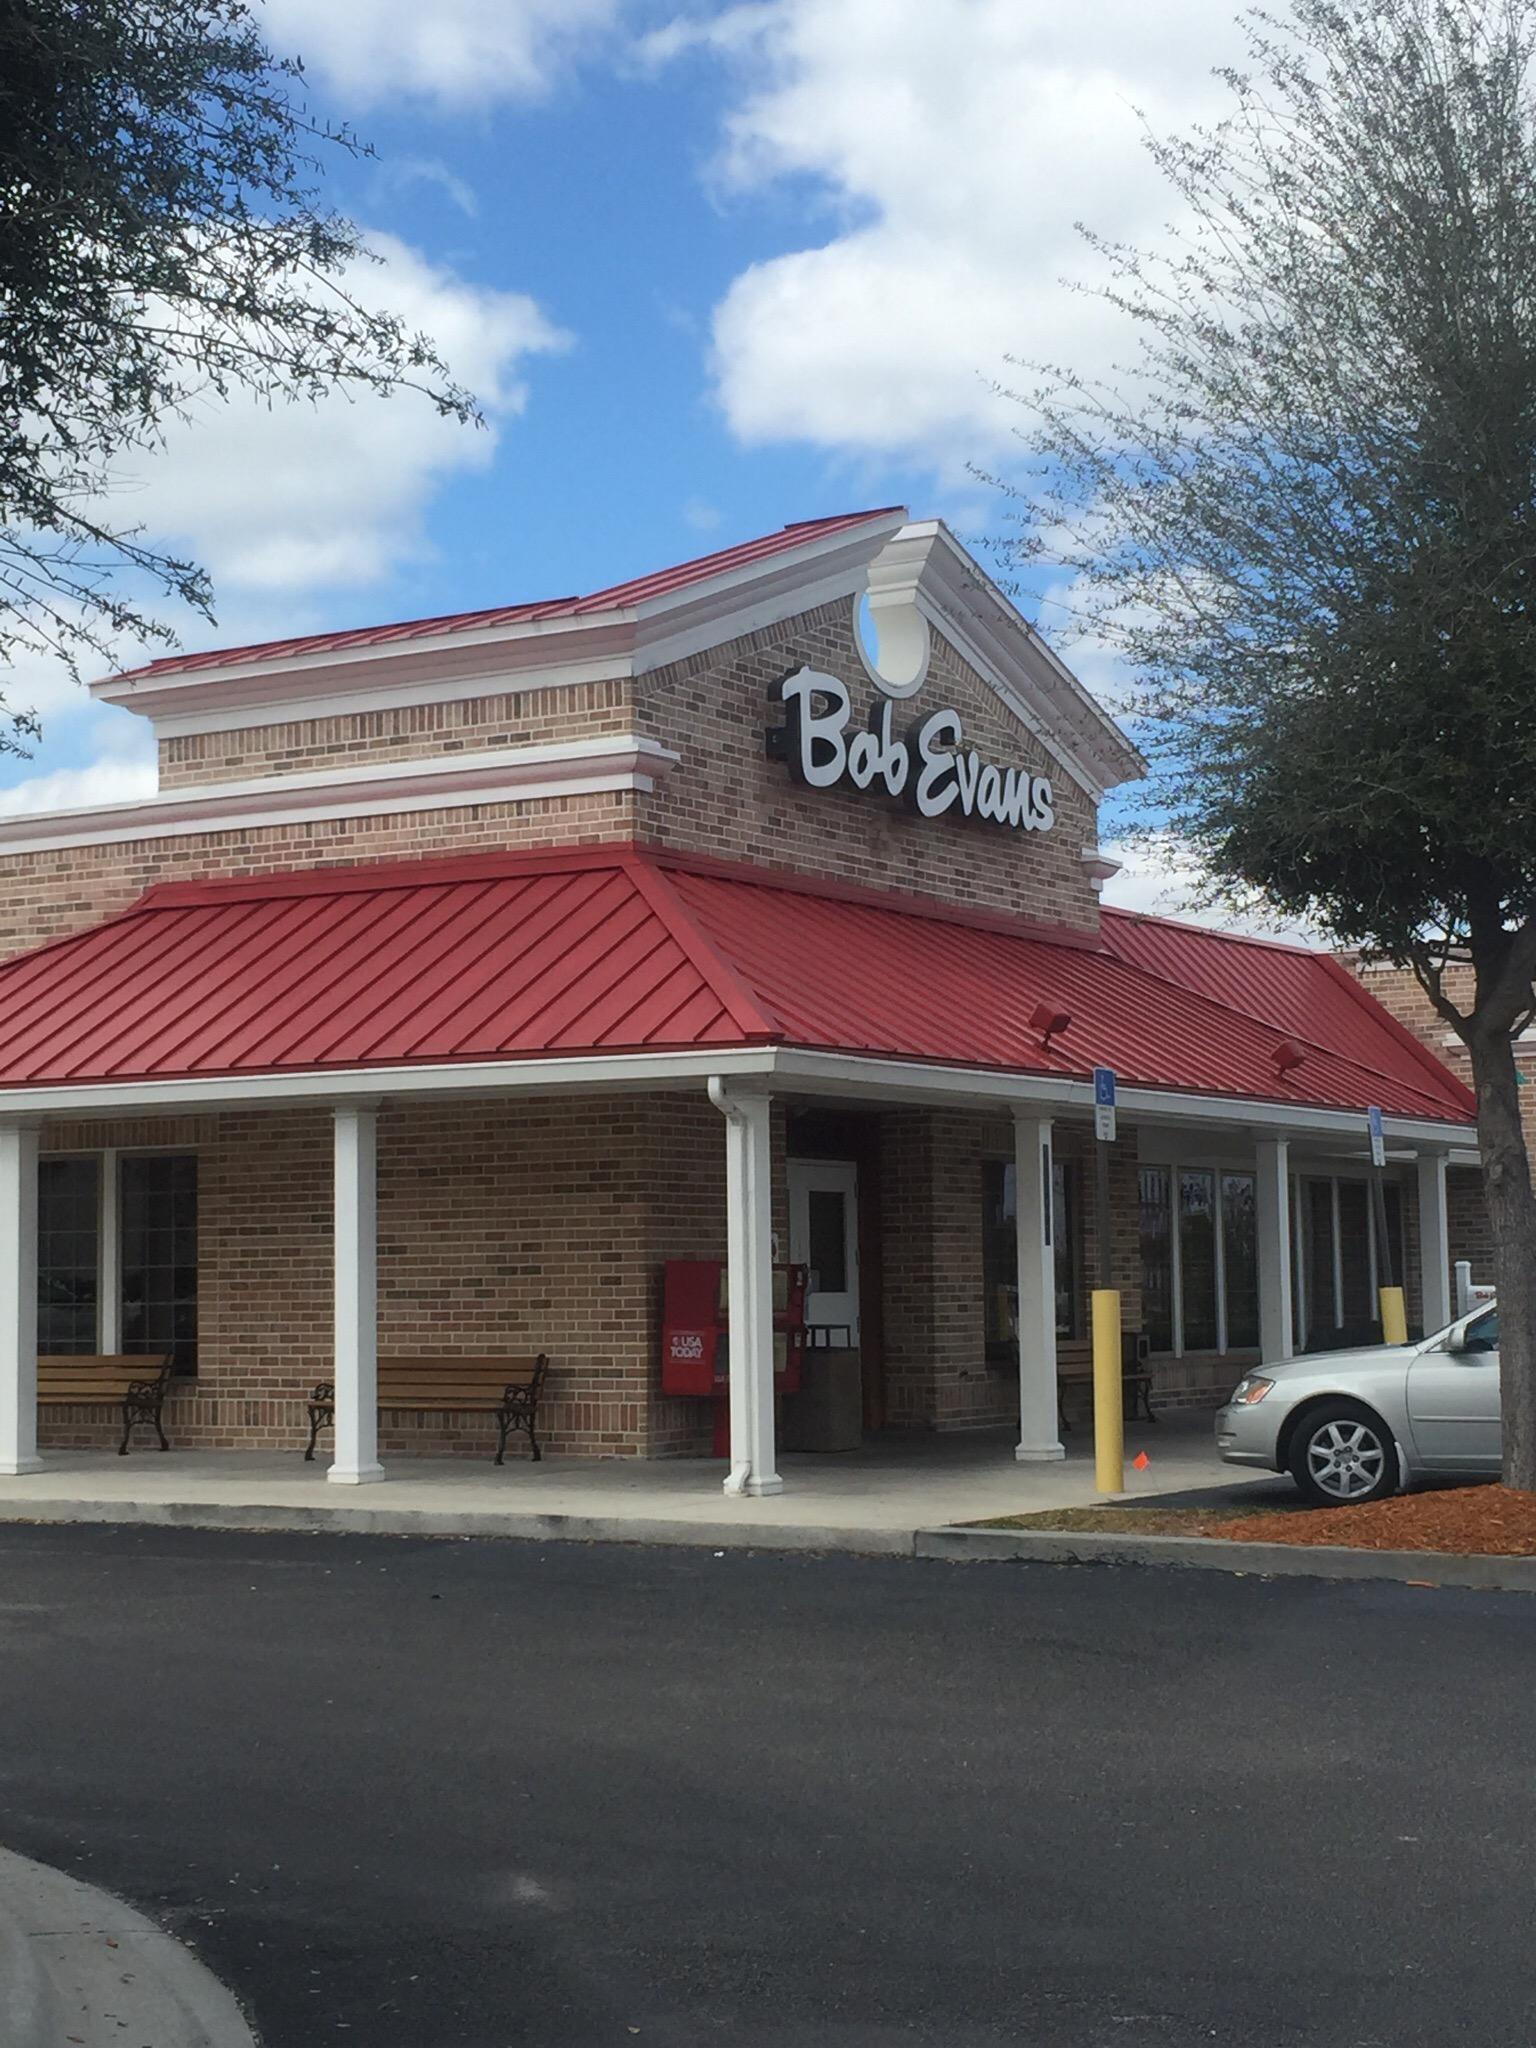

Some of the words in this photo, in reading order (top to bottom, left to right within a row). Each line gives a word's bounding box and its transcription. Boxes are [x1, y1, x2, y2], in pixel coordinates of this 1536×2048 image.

[782, 666, 908, 796] Bob
[916, 709, 1054, 832] Evans
[681, 1336, 703, 1347] USA
[670, 1346, 704, 1358] TODAY
